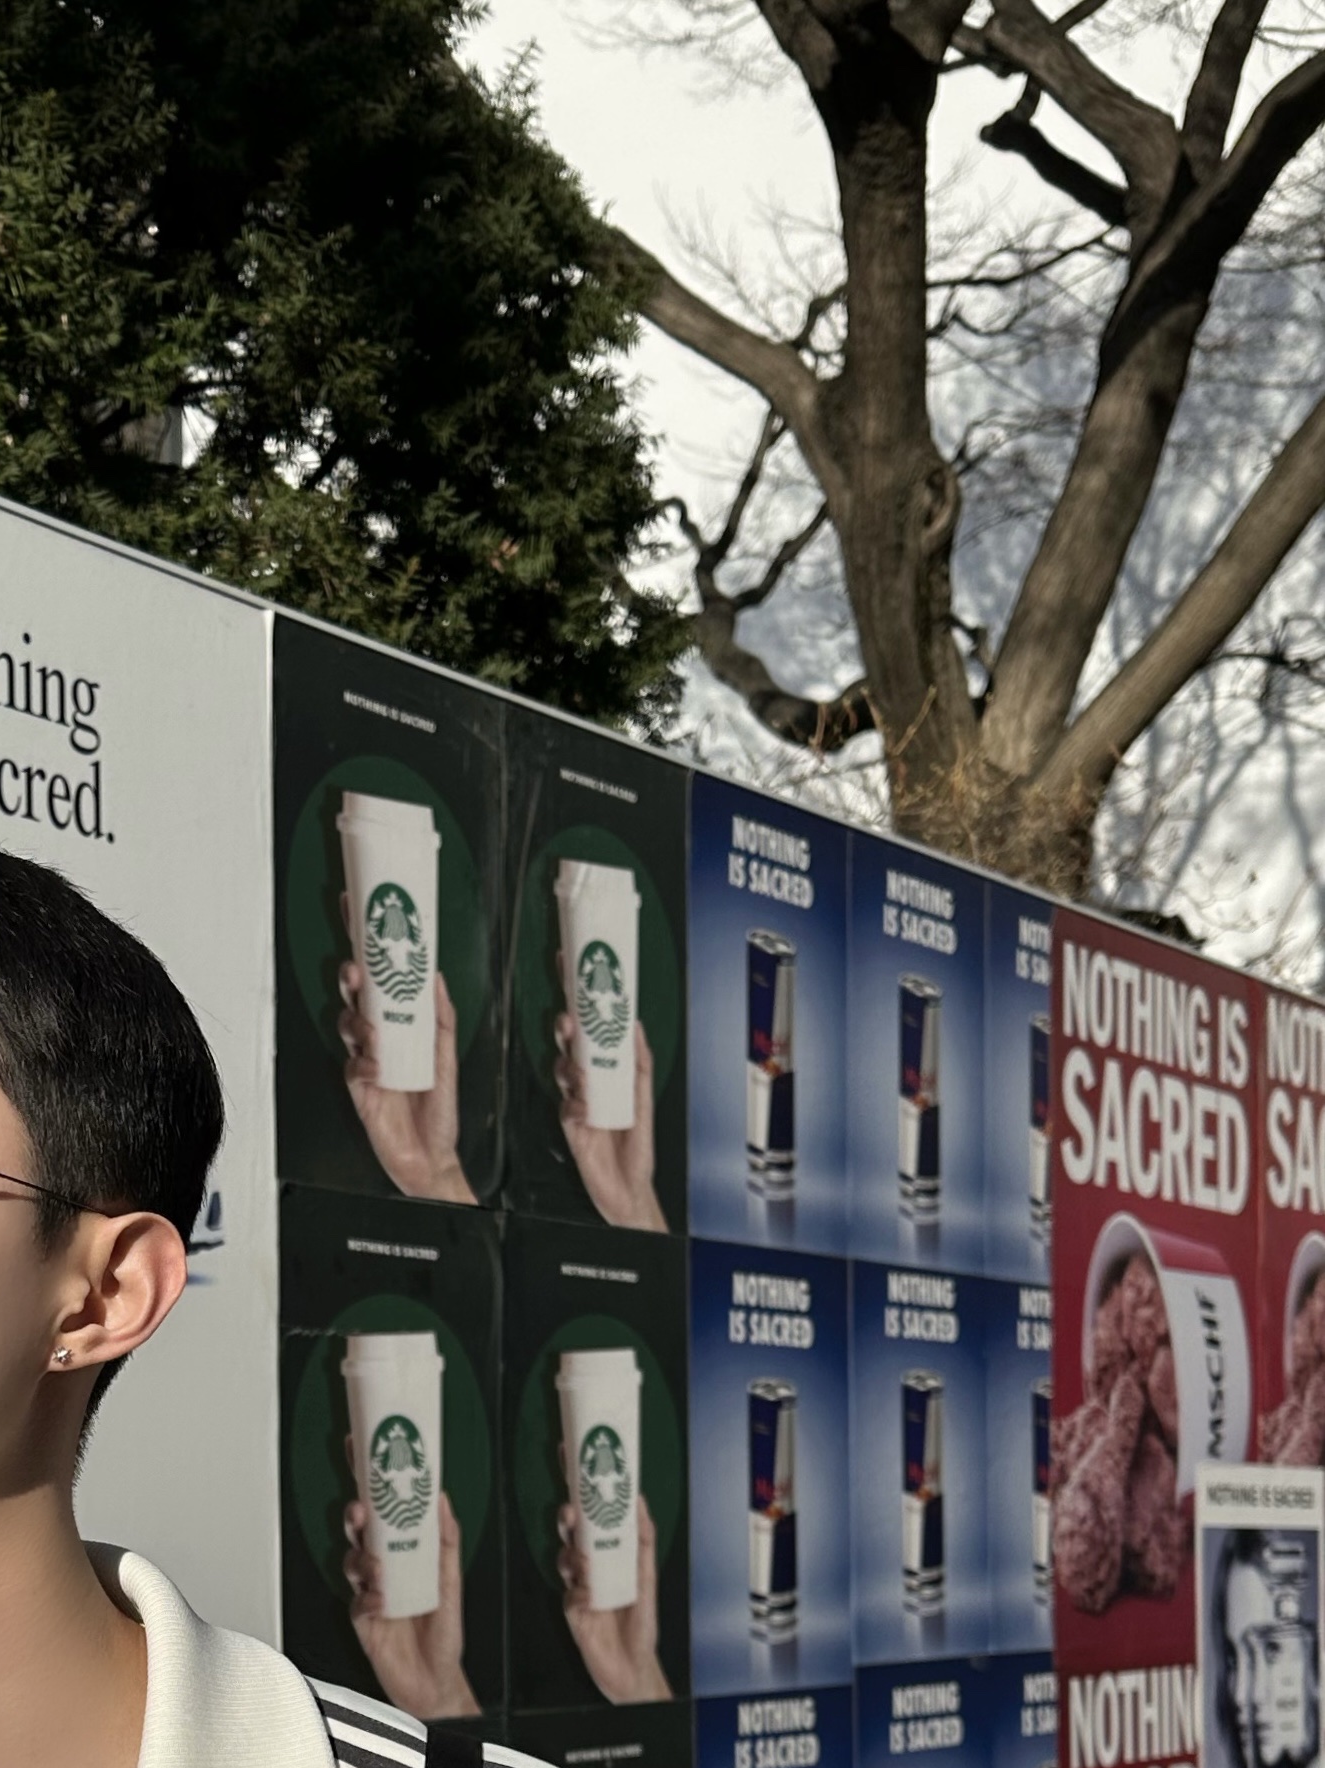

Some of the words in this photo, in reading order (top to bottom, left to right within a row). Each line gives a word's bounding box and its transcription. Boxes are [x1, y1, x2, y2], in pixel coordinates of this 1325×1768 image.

[732, 815, 811, 873] NOTHING
[728, 851, 747, 889] IS
[748, 859, 814, 910] SACRED
[886, 868, 954, 920] NOTHING
[883, 903, 898, 937] IS
[900, 910, 958, 955] SACRED
[1015, 947, 1030, 978] IS
[1063, 939, 1211, 1078] NOTHING
[1218, 995, 1248, 1089] IS
[1060, 1047, 1250, 1216] SACRED
[732, 1271, 811, 1313] NOTHING
[887, 1271, 955, 1309] NOTHING
[729, 1308, 746, 1345] IS
[749, 1309, 814, 1349] SACRED
[884, 1306, 900, 1338] IS
[902, 1307, 959, 1344] SACRED
[1017, 1319, 1030, 1350] IS
[1194, 1286, 1226, 1459] MSCHF
[737, 1696, 816, 1737] NOTHING
[892, 1680, 960, 1719] NOTHING
[889, 1720, 904, 1754] IS
[907, 1714, 964, 1752] SACRED
[1021, 1706, 1034, 1737] IS
